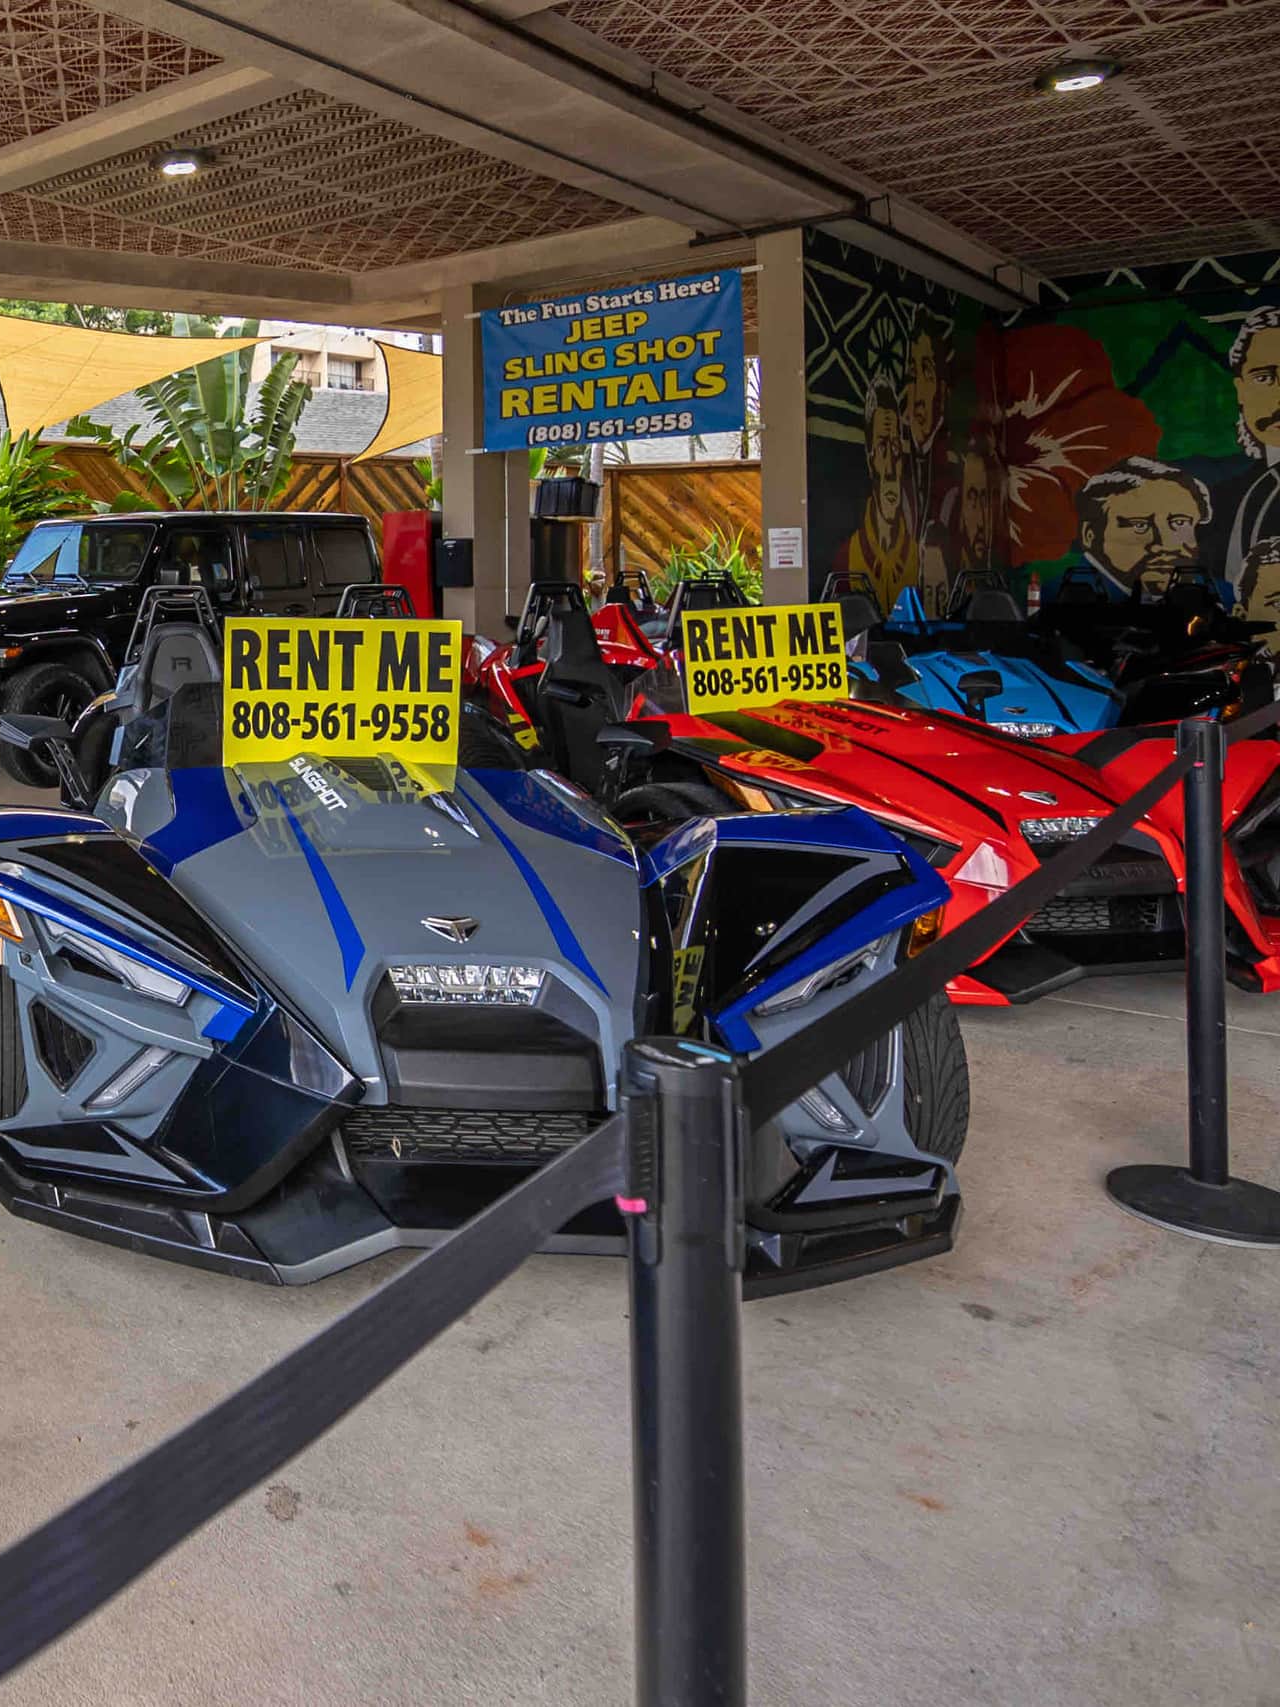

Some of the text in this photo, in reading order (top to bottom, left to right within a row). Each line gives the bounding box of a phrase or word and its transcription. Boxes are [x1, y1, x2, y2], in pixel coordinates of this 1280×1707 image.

[500, 275, 721, 326] The Fun Starts Here!
[566, 311, 648, 344] JEEP
[504, 330, 721, 380] SLING SHOT
[500, 364, 728, 419] RENTALS
[528, 412, 693, 445] (808) 561-9558
[230, 629, 454, 693] RENT ME
[687, 611, 841, 662] RENT ME
[693, 662, 842, 697] 808-561-9558
[232, 701, 451, 742] 808-561-9558
[288, 757, 349, 811] SLINGSHOT
